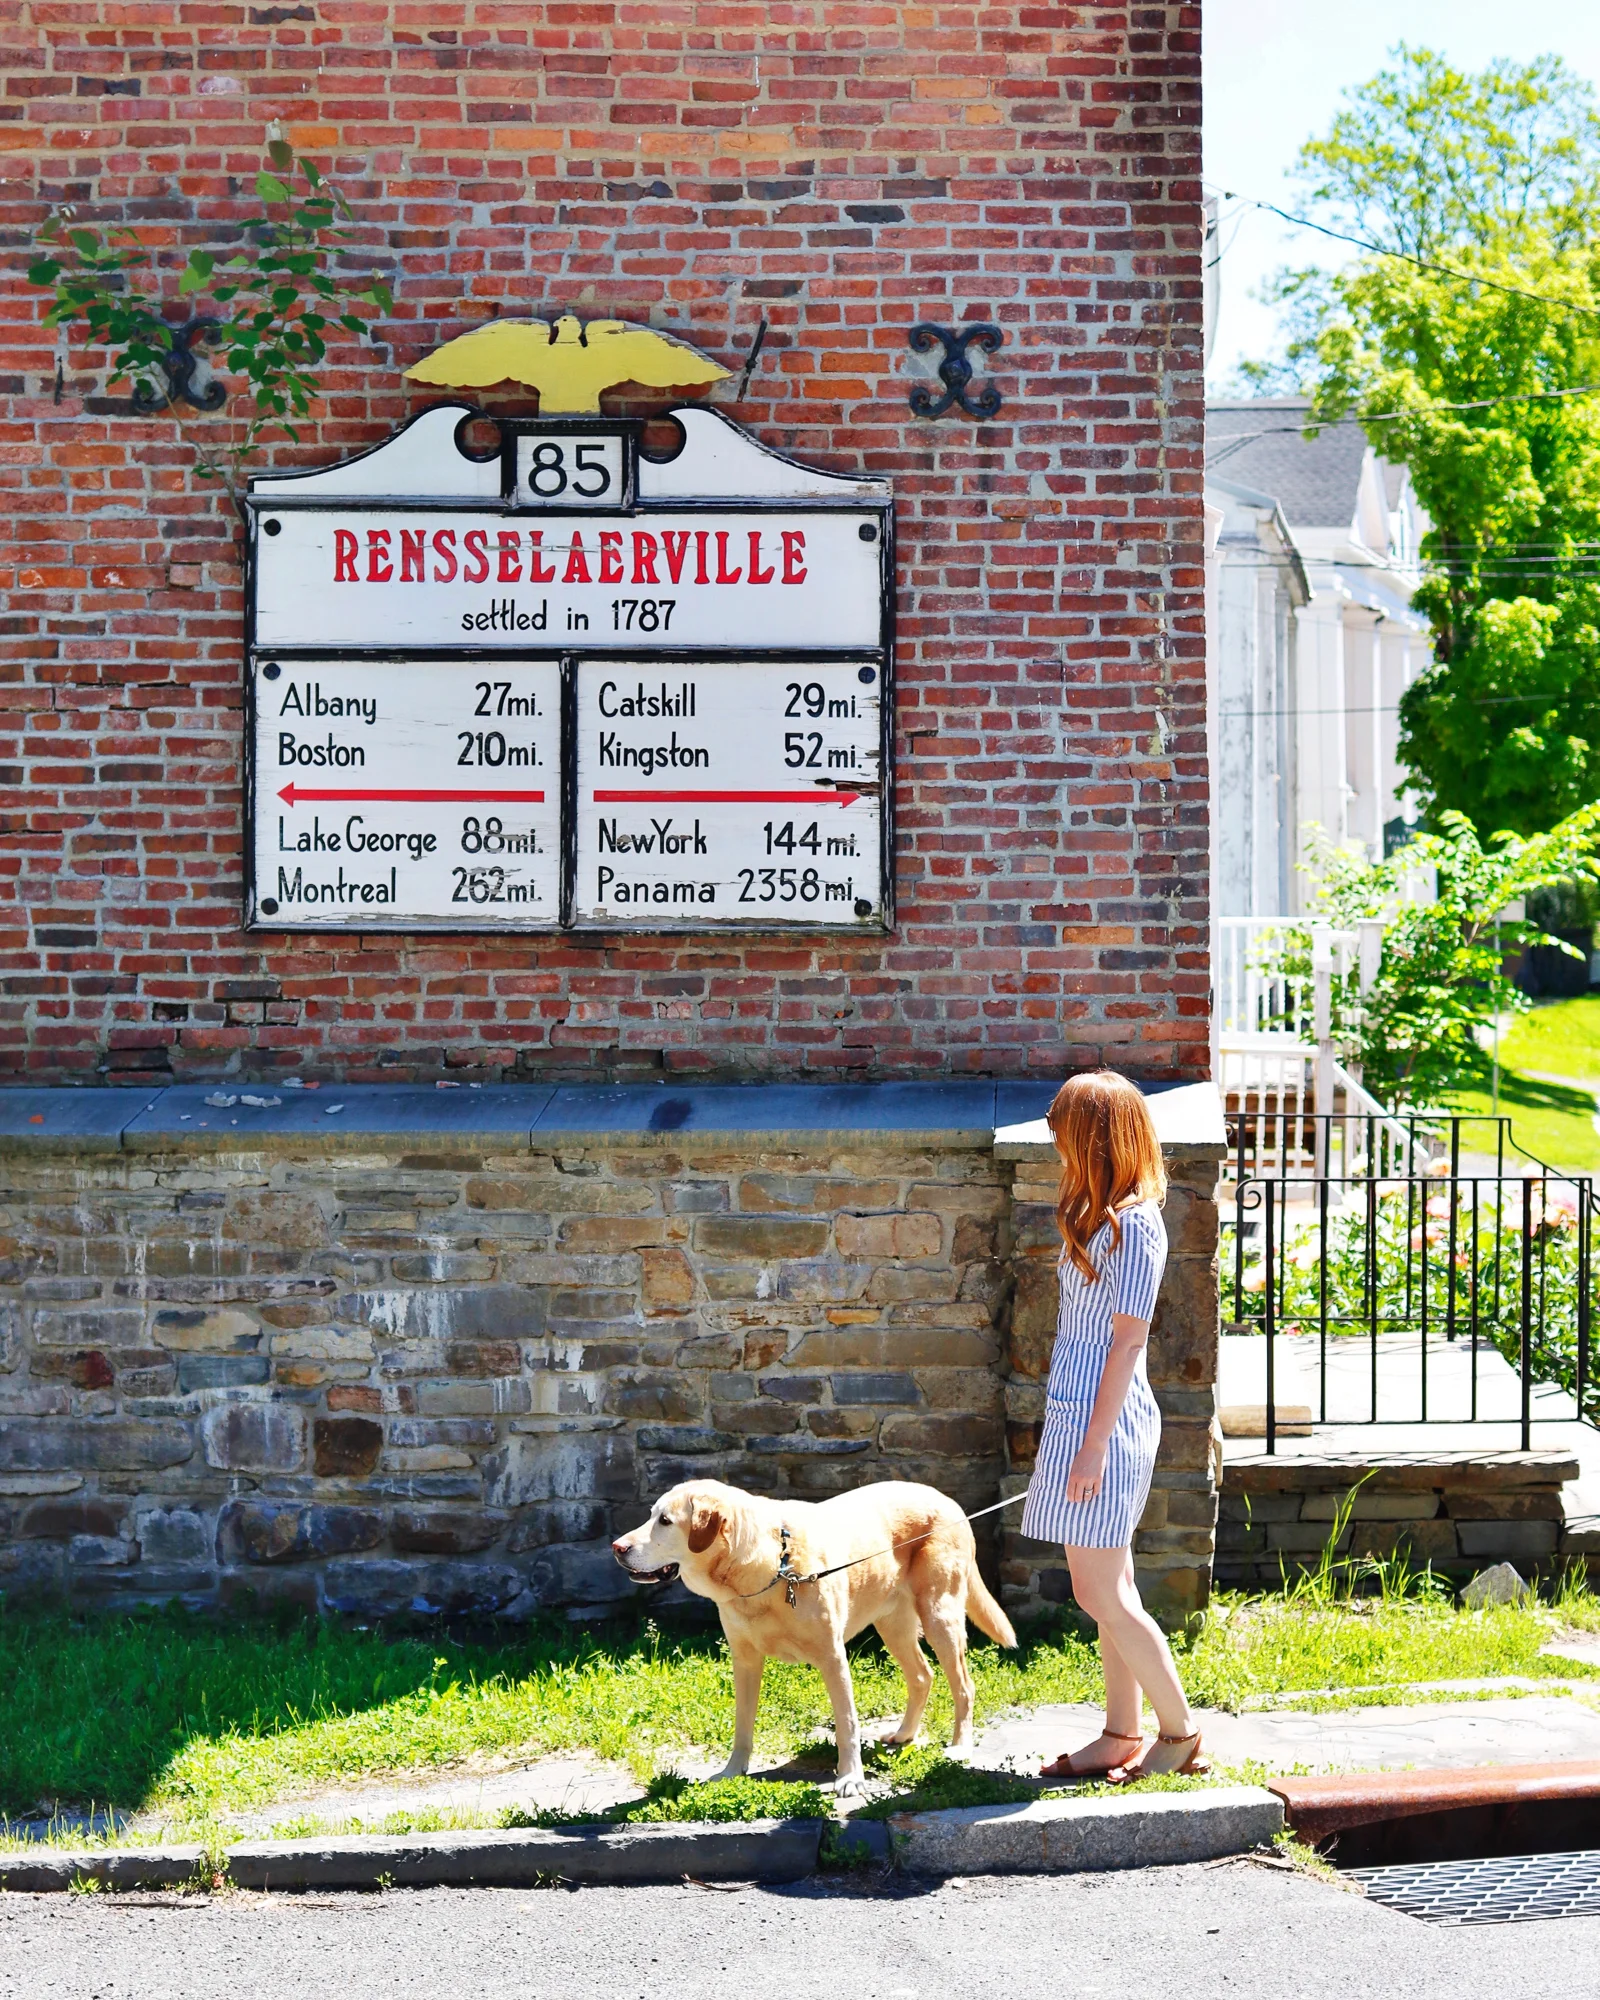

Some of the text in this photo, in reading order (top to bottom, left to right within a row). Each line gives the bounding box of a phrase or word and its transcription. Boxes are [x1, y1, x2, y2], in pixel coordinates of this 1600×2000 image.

[527, 442, 611, 498] 85
[334, 529, 808, 585] RENSSELAERVILLE
[460, 598, 677, 632] settled in 1787
[279, 682, 377, 726] Albany
[598, 681, 696, 718] Catskill
[278, 731, 365, 767] Boston
[599, 731, 709, 777] Kingston
[277, 865, 397, 904] Montreal
[597, 865, 719, 904] Panama
